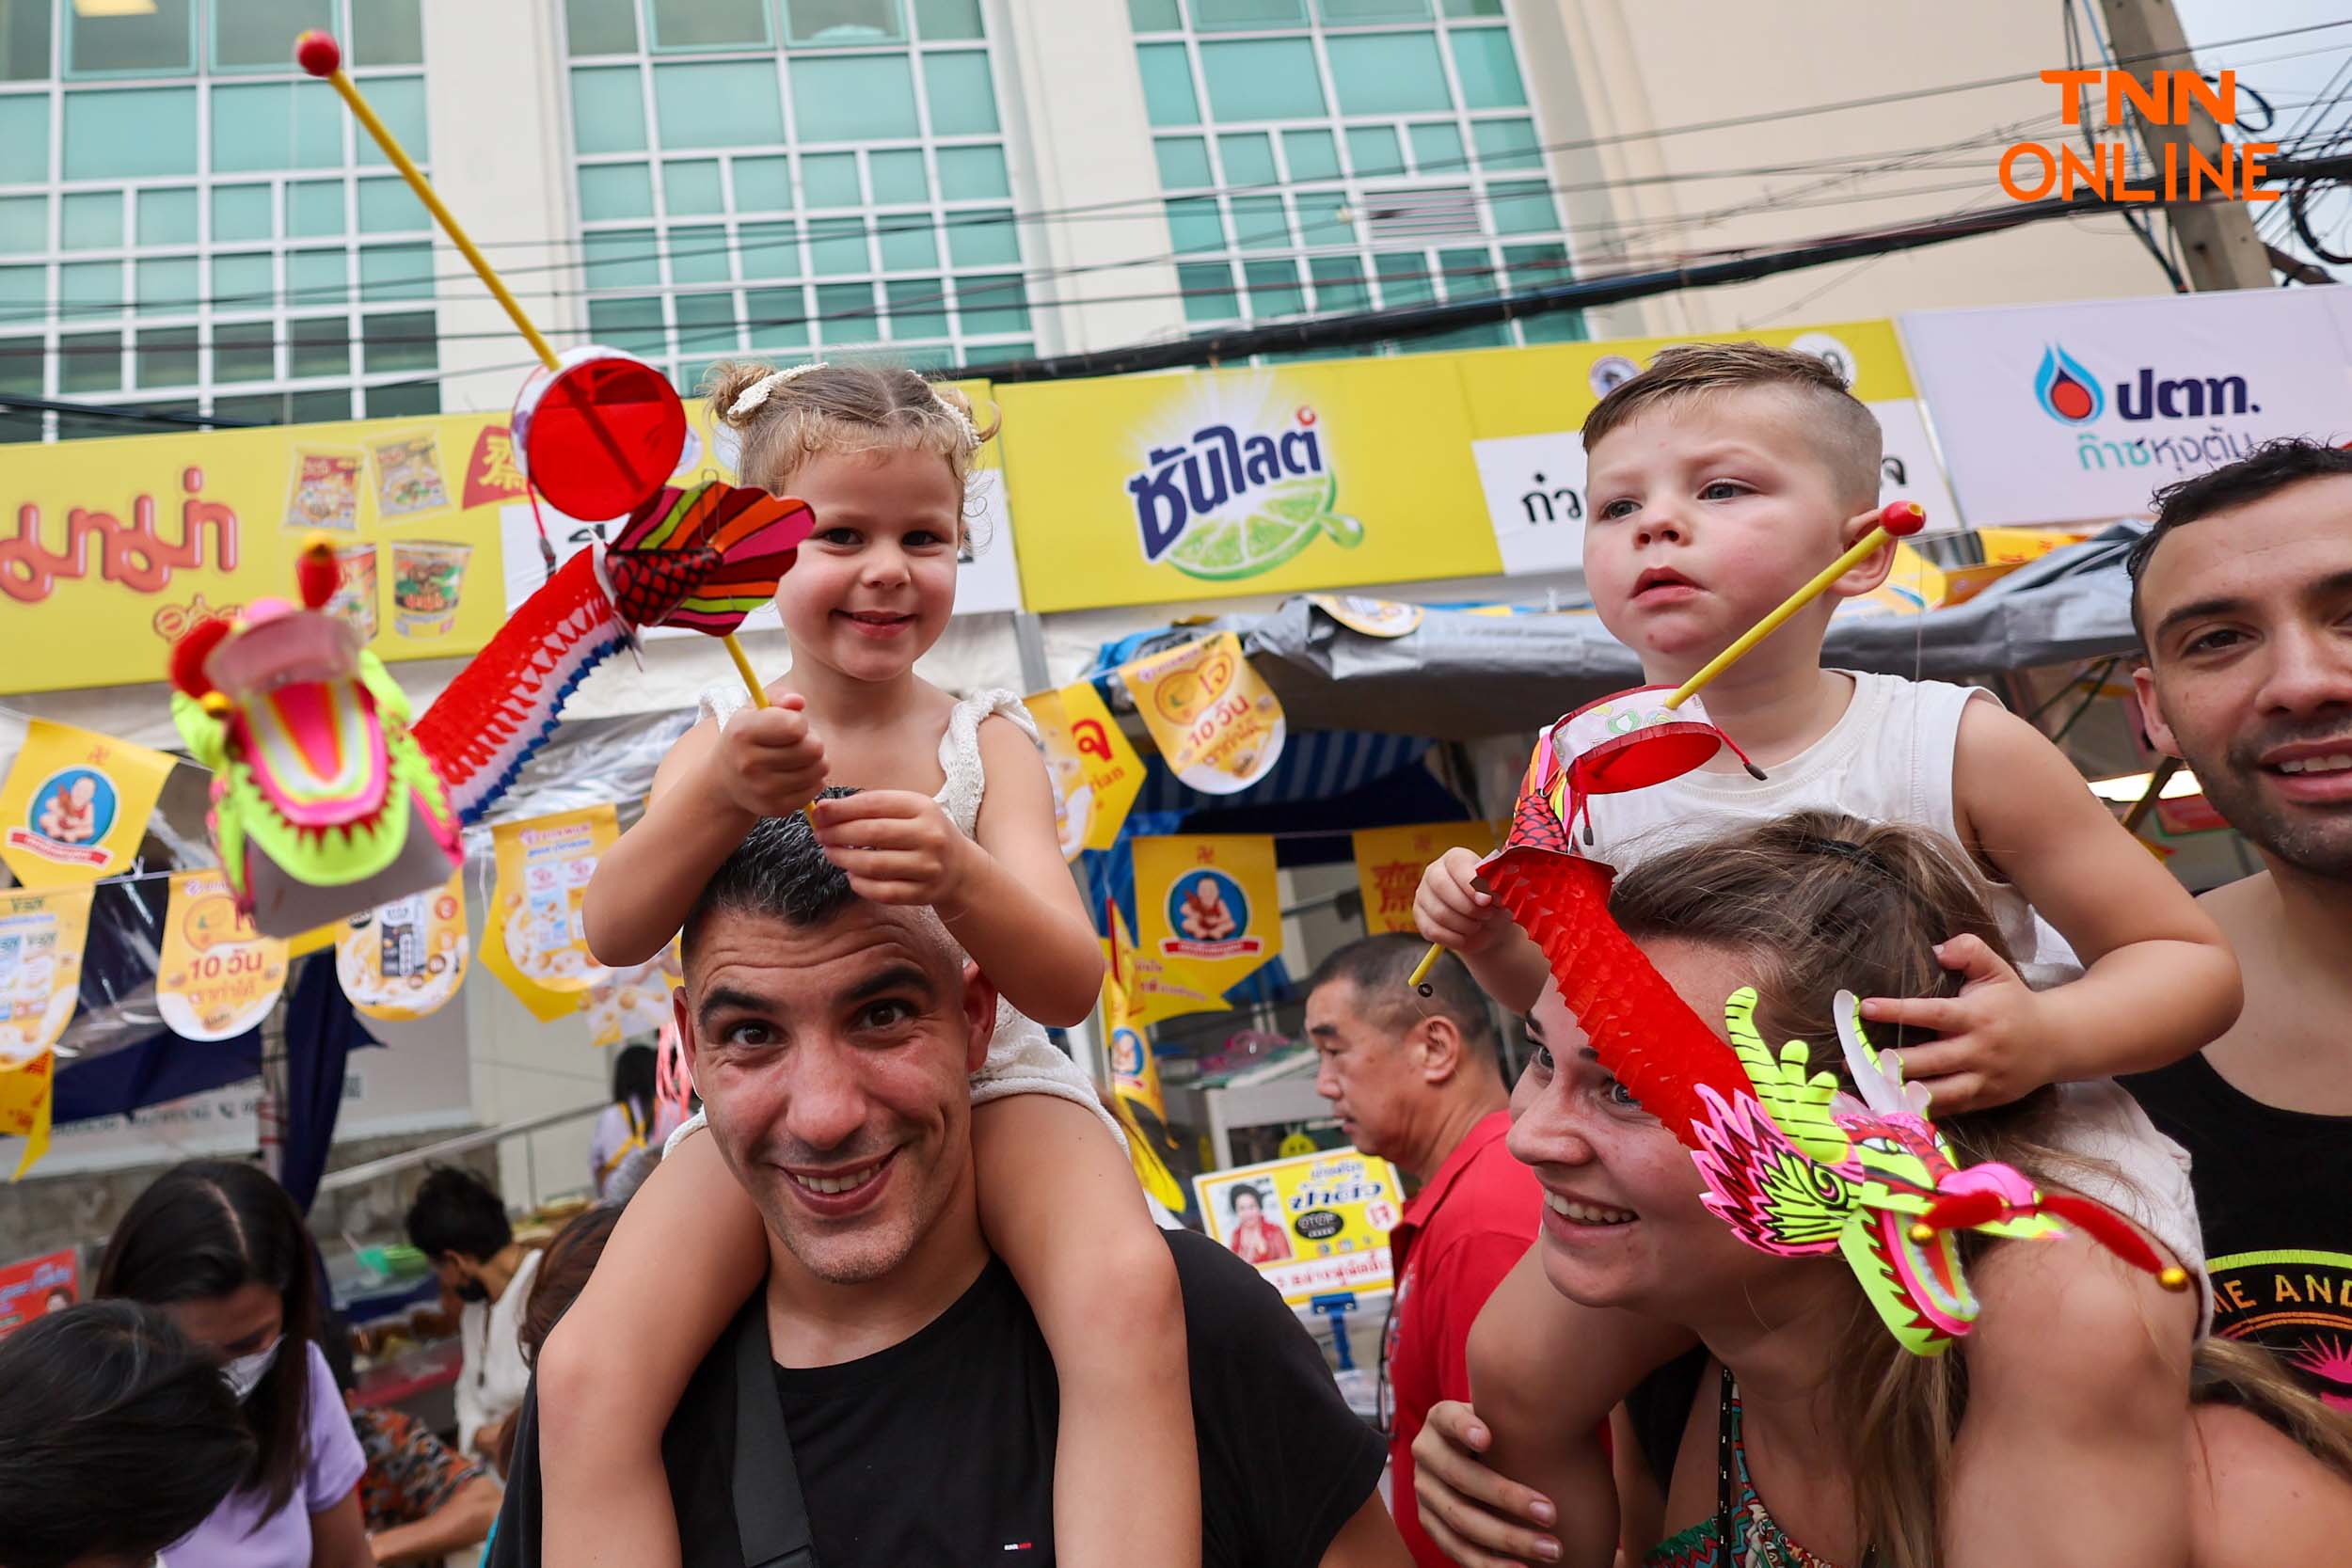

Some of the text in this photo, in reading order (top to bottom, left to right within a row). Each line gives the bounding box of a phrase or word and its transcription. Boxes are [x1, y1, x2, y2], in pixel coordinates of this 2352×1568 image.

[2116, 368, 2262, 421] ปตท.
[1128, 404, 1323, 562] ซันไลต์
[1072, 719, 1114, 764] จ
[189, 955, 221, 979] 10
